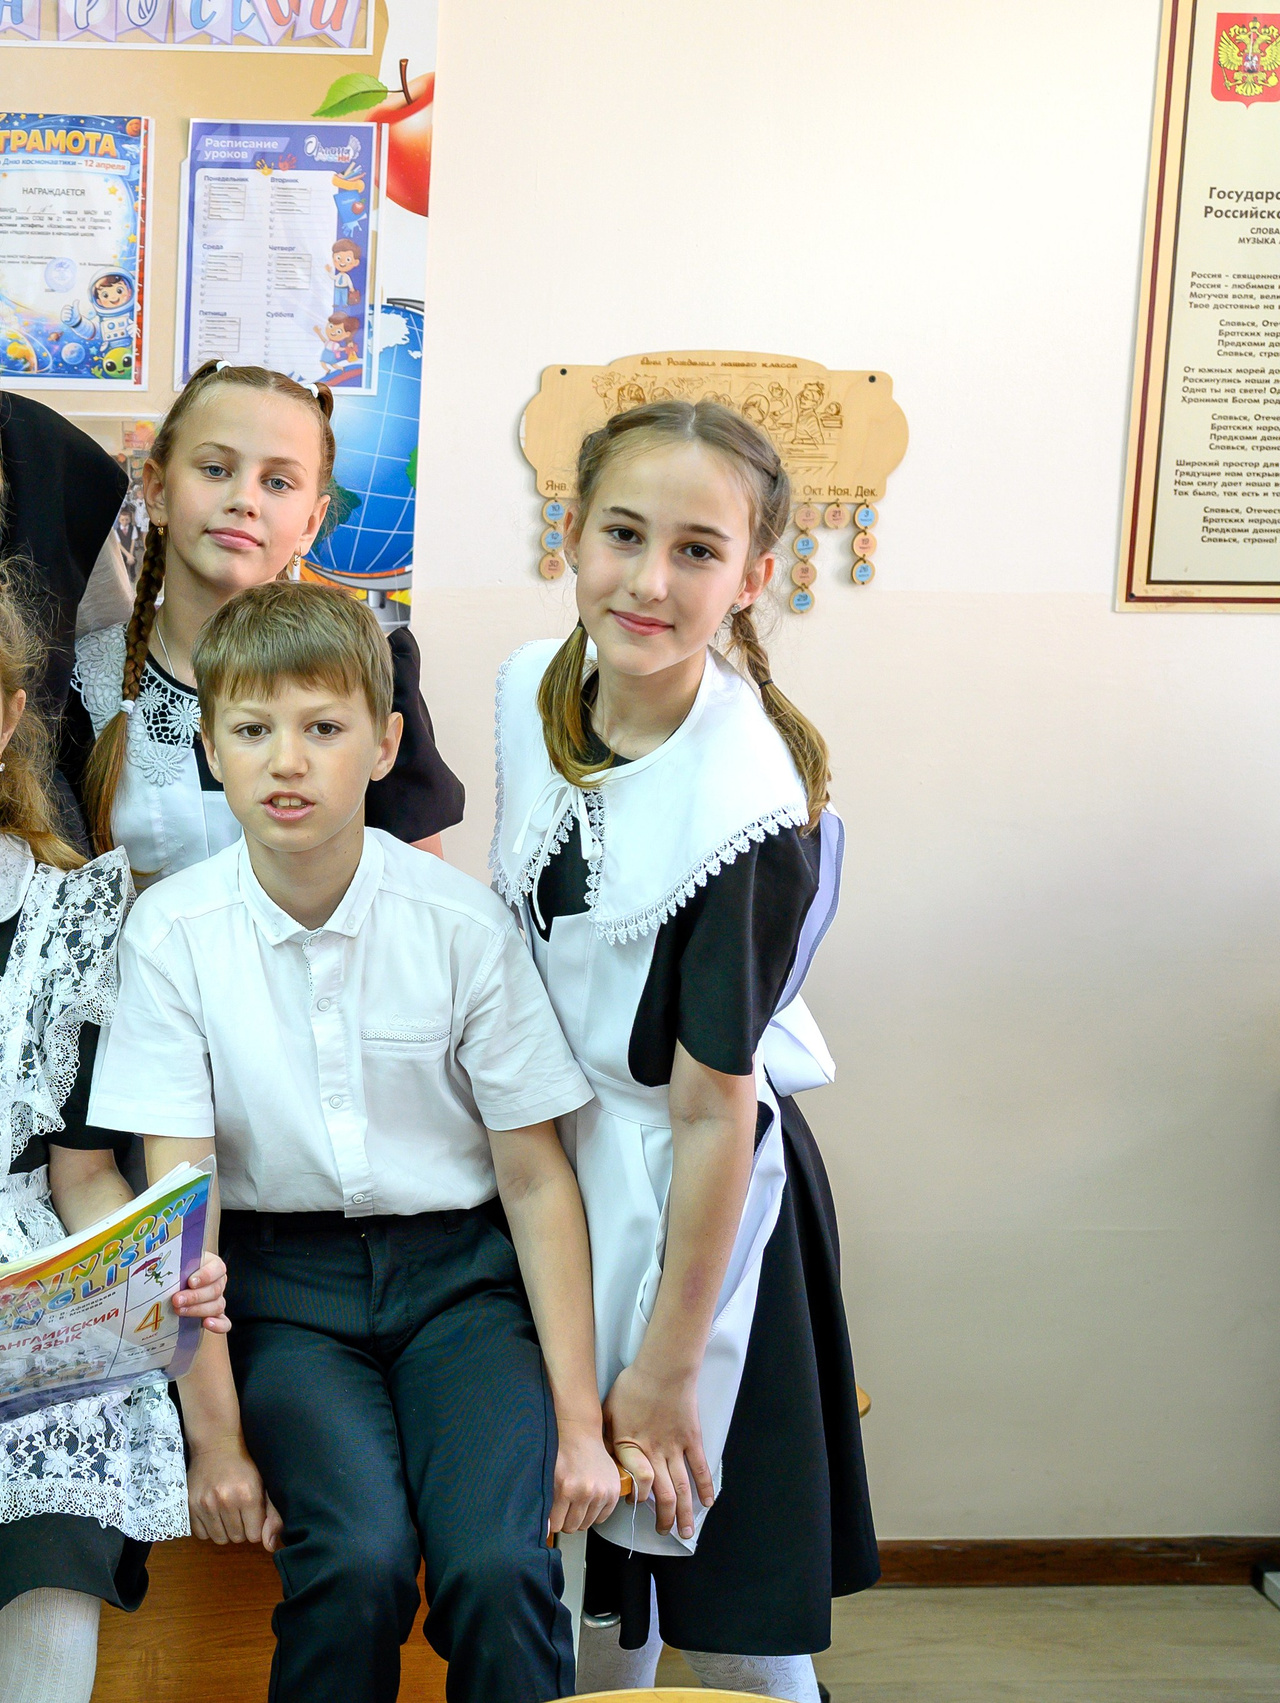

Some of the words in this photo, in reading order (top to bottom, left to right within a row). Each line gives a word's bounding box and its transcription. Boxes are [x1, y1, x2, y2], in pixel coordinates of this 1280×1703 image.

[205, 138, 278, 149] Расписание
[204, 151, 248, 160] уроков
[95, 162, 125, 170] апреля
[22, 187, 86, 196] НАГРАЖДАЕТСЯ
[1189, 292, 1228, 300] Могучая
[1219, 319, 1258, 328] Славься,
[1218, 330, 1261, 338] Братских
[1218, 339, 1265, 348] Предками
[1217, 349, 1256, 358] Славься,
[1236, 367, 1265, 375] морей
[1211, 414, 1250, 422] Славься,
[1210, 423, 1253, 431] Братских
[1210, 433, 1258, 442] Предками
[1209, 443, 1248, 451] Славься,
[546, 480, 569, 491] Янв.
[803, 485, 824, 496] Окт.
[828, 485, 852, 496] Ноя.
[855, 486, 878, 498] Дек.
[1202, 516, 1244, 524] Братских
[1202, 526, 1249, 534] Предками
[134, 1301, 165, 1334] 4
[31, 1332, 82, 1353] ЯЗЫК
